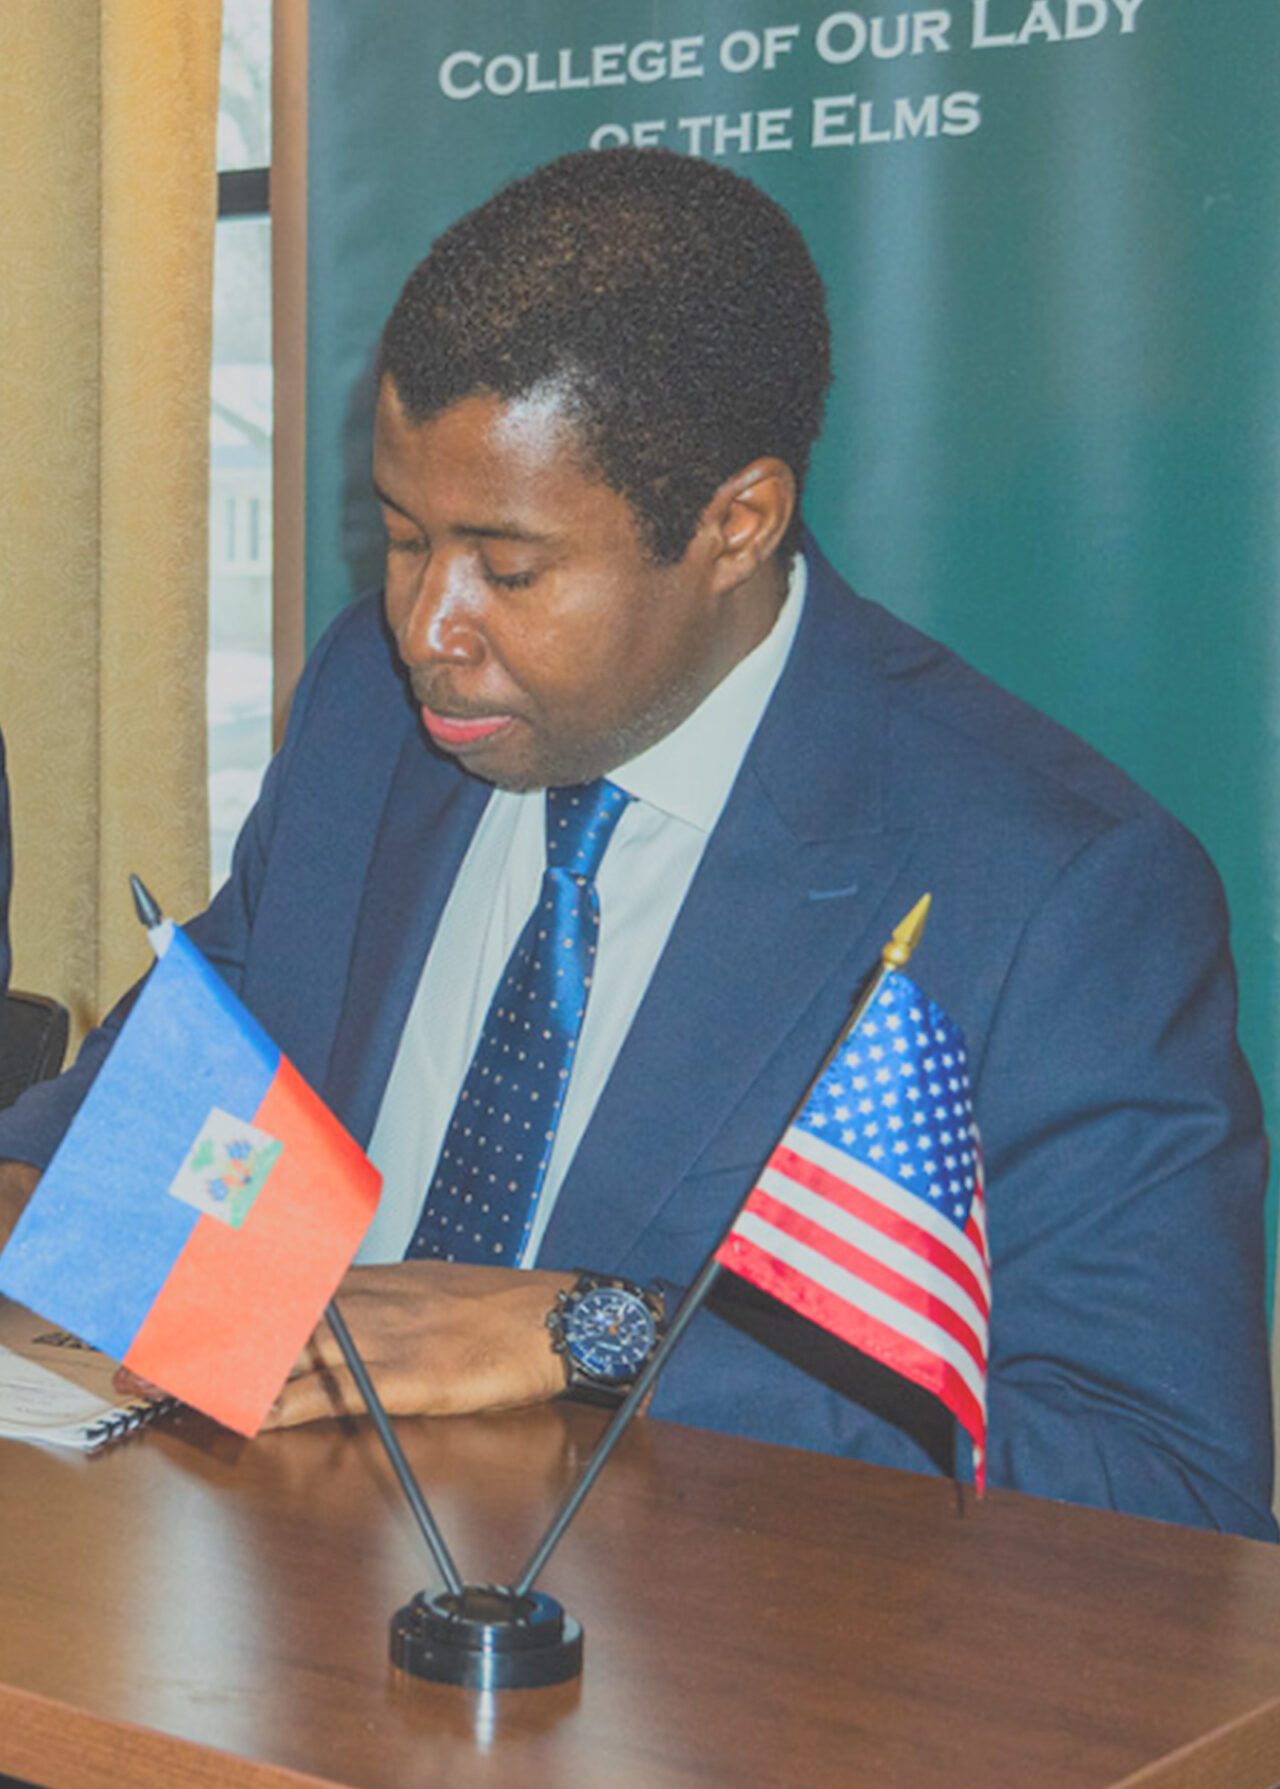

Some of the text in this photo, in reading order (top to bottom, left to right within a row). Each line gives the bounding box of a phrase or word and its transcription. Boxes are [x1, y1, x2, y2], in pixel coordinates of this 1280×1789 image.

[438, 0, 1146, 100] COLLEGE OF OUR LADY
[589, 91, 981, 156] OF THE ELMS
